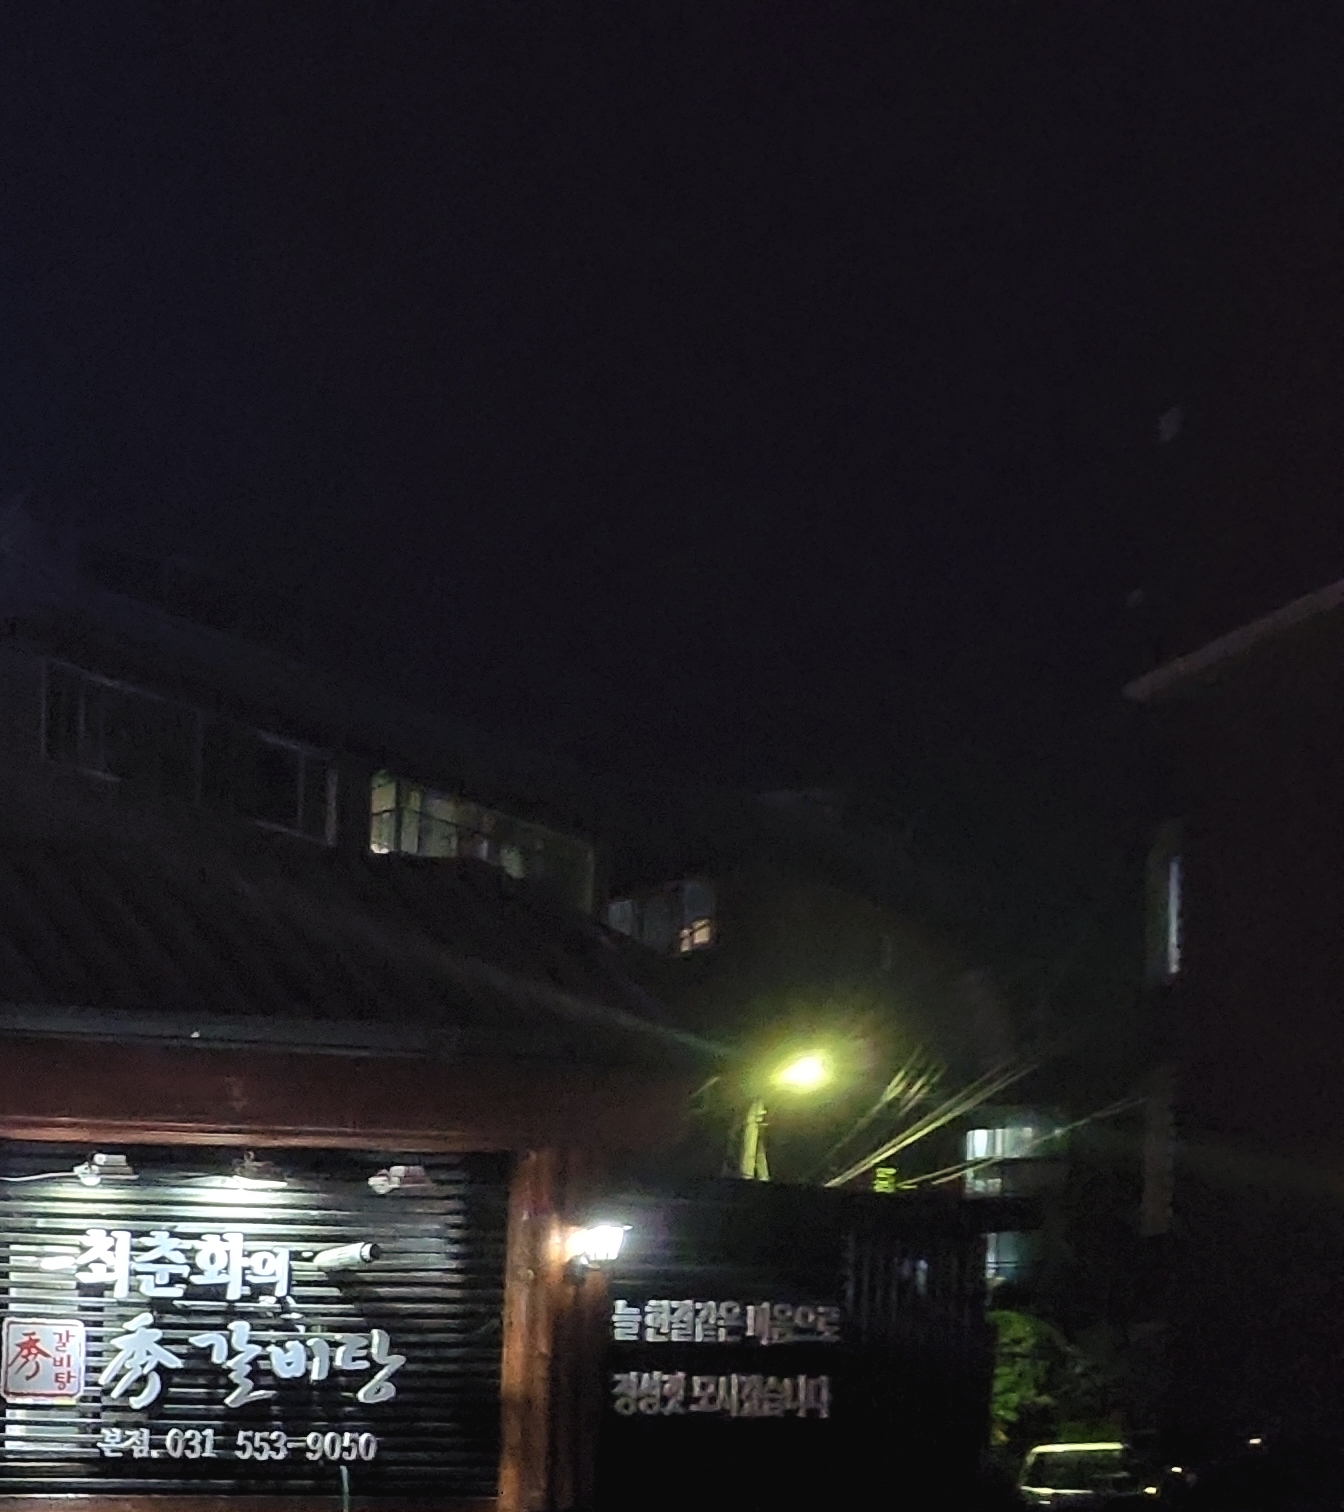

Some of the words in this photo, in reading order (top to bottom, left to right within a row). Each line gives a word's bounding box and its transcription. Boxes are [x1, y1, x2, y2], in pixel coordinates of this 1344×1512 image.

[75, 1229, 292, 1300] 최춘화의
[52, 1329, 77, 1391] 갈비탕
[233, 1431, 379, 1462] 553-9050
